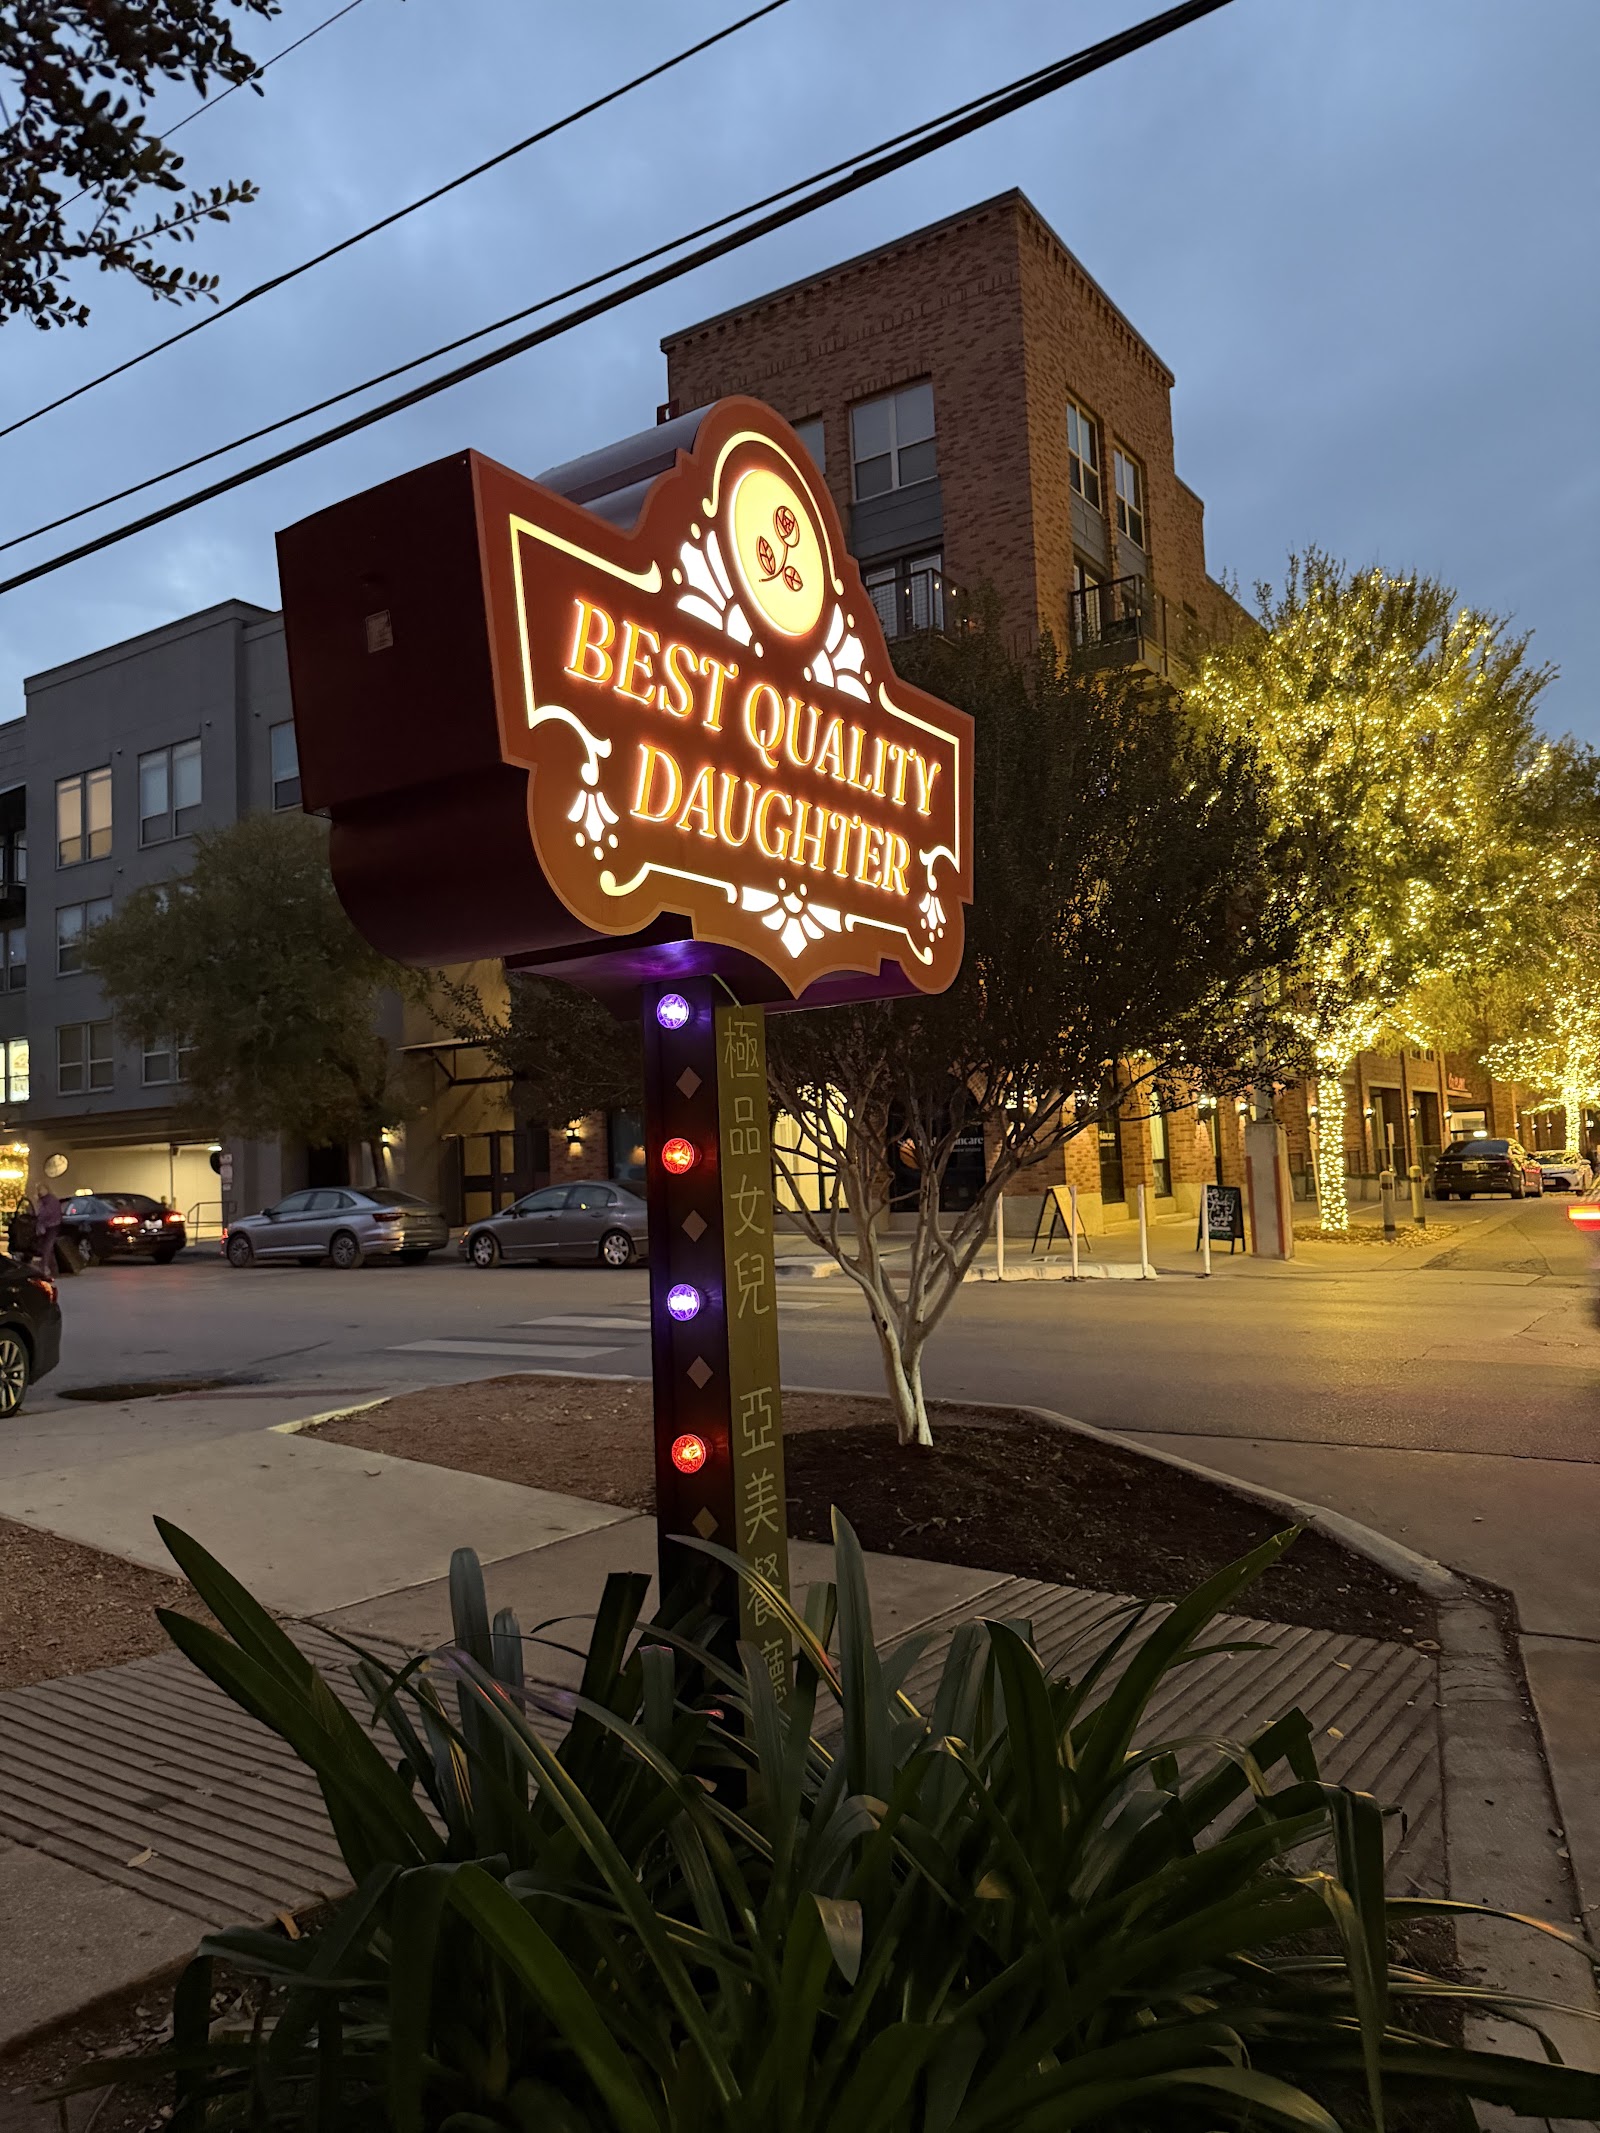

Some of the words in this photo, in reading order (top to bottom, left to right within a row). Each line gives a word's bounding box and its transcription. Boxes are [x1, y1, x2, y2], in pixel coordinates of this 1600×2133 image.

[563, 597, 740, 732] BEST
[744, 682, 942, 817] QUALITY
[629, 742, 911, 897] DAUGHTER
[723, 1015, 770, 1319] 極品女兒
